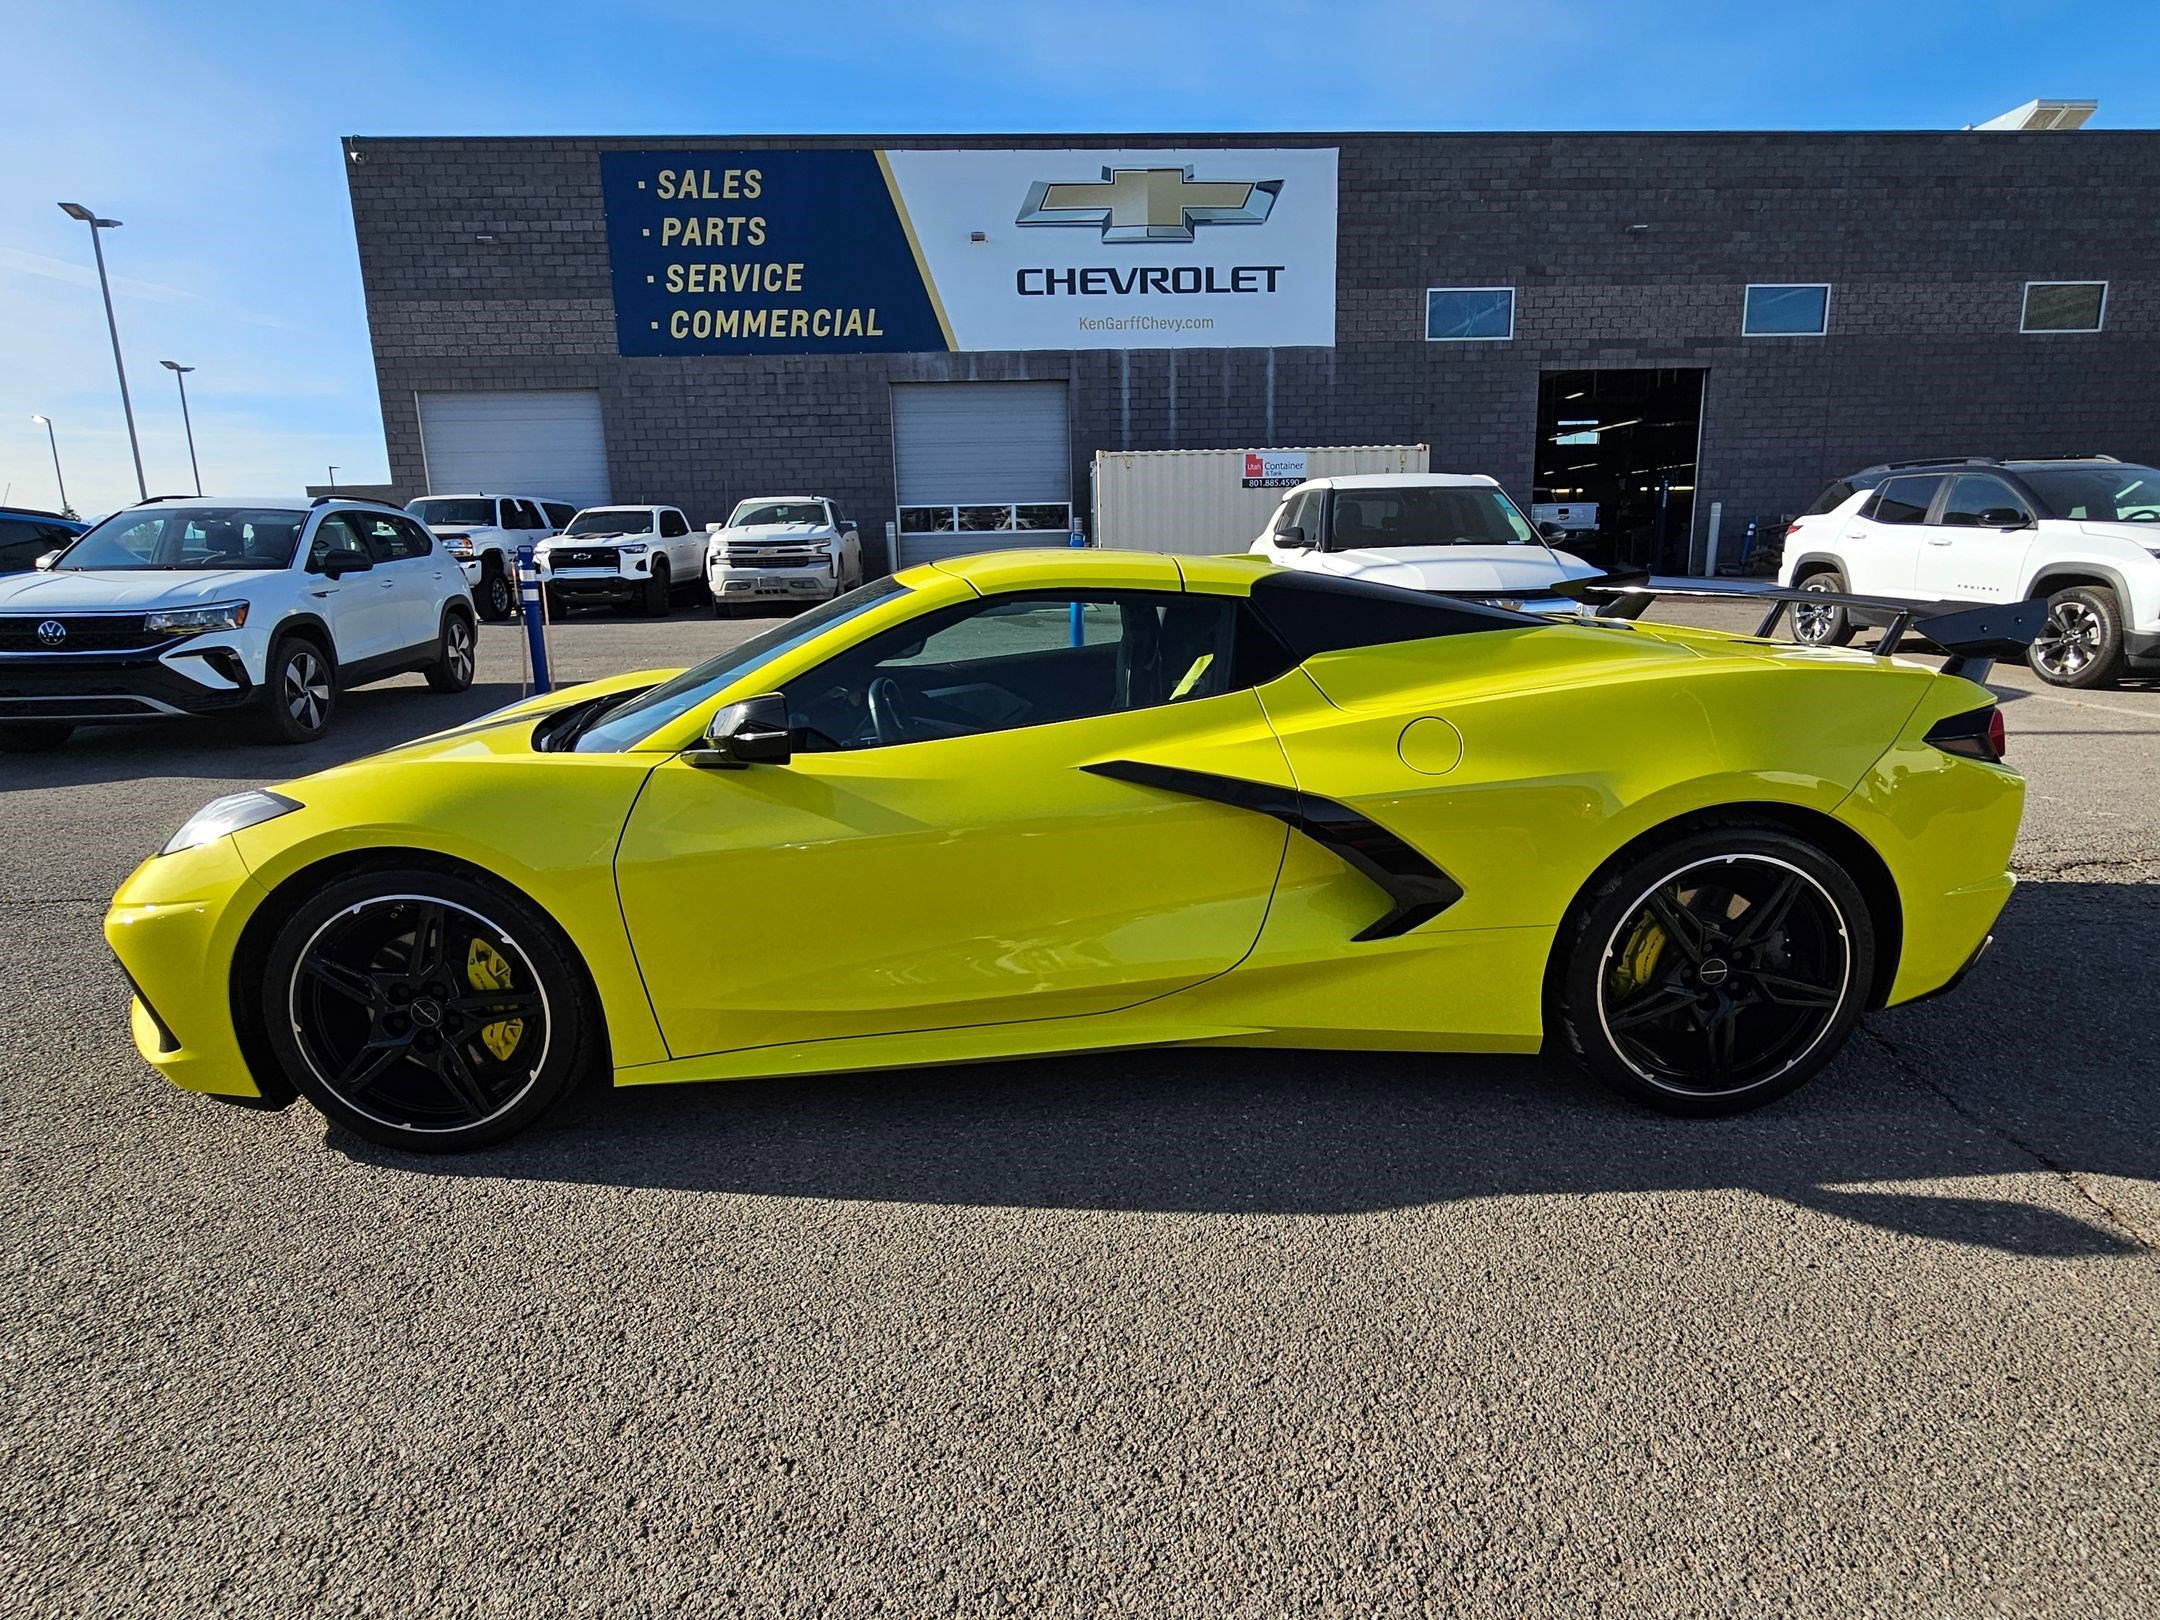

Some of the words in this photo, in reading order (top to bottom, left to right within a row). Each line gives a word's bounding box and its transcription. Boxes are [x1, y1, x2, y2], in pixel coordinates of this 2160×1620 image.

[657, 169, 762, 199] SALES
[662, 216, 766, 246] PARTS
[665, 263, 804, 293] SERVICE
[1016, 265, 1285, 295] CHEVROLET
[670, 308, 883, 339] COMMERCIAL
[1079, 316, 1214, 332] KenGarffChevy.com
[1264, 462, 1304, 470] Container
[1248, 479, 1300, 487] 801.885.4590
